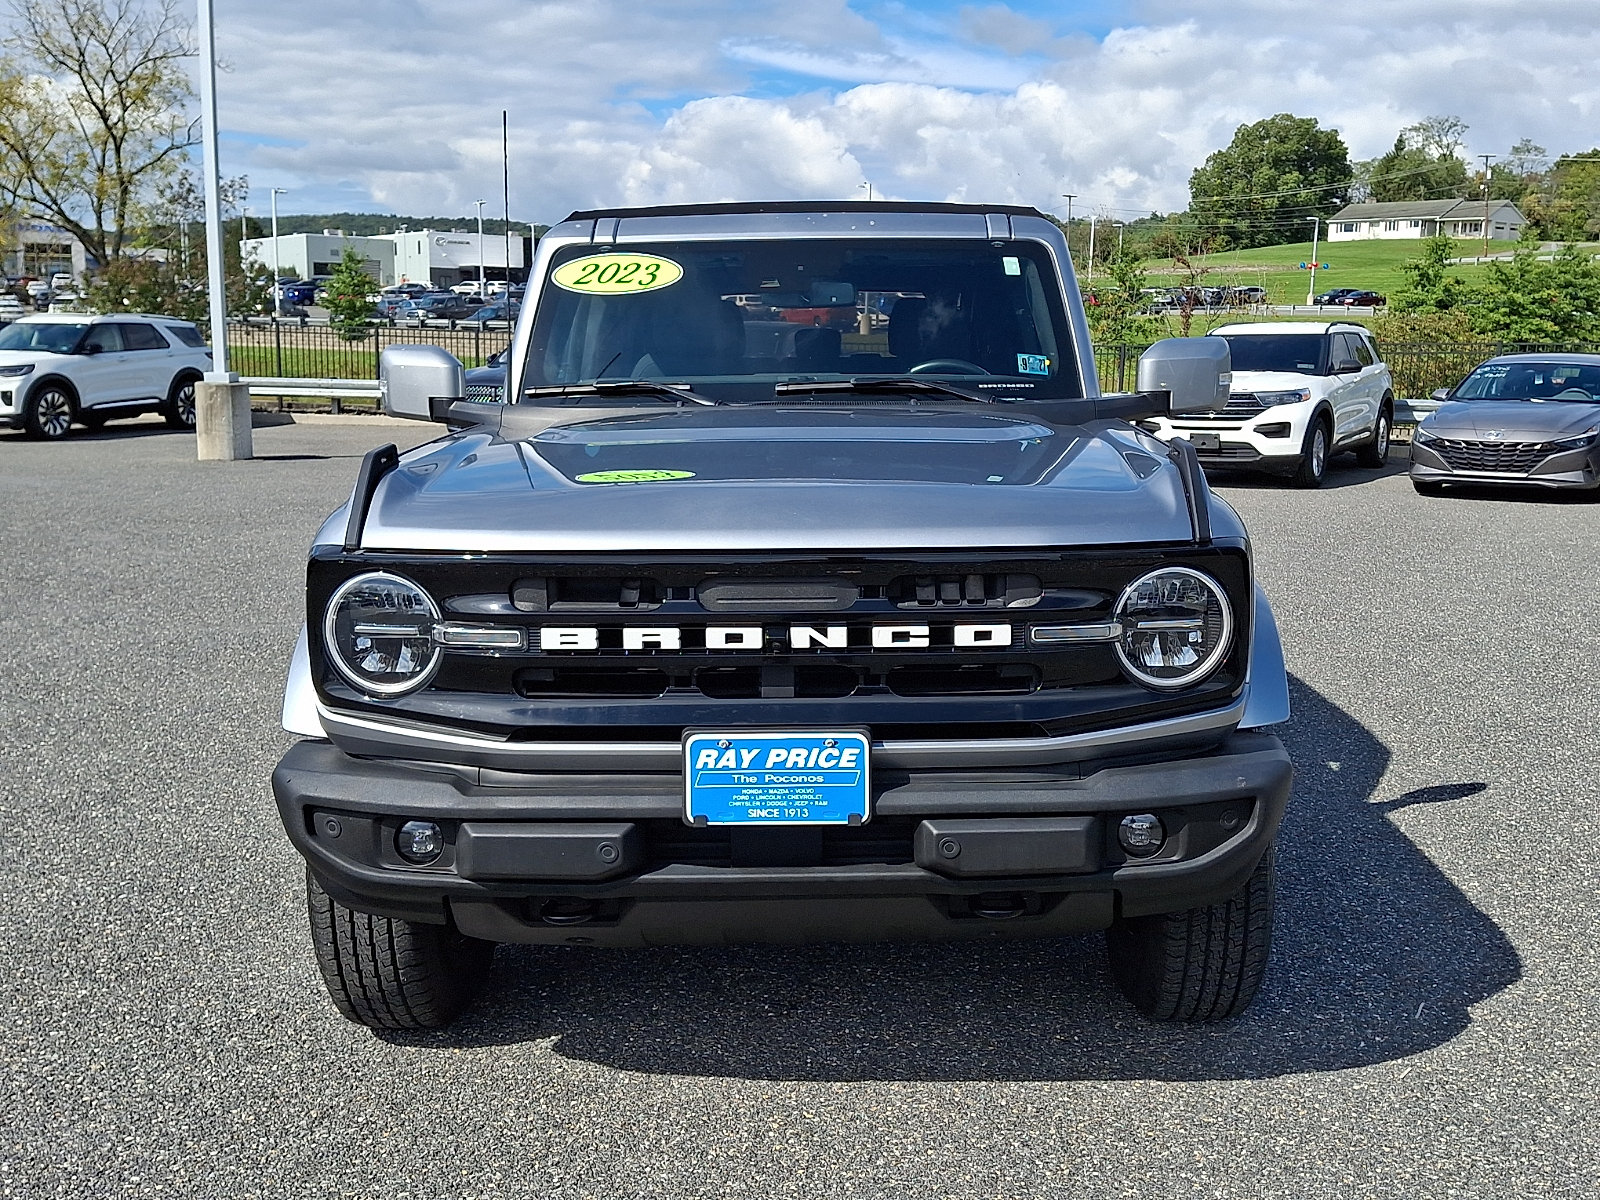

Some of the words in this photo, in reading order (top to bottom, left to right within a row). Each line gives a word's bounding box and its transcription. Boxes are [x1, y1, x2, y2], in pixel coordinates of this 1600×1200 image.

[573, 262, 661, 286] 2023
[539, 624, 1012, 650] BRONCO
[695, 748, 761, 769] RAY
[765, 747, 861, 769] PRICE
[731, 774, 758, 783] The
[764, 774, 825, 783] Poconos
[747, 808, 780, 818] SINCE
[783, 808, 809, 818] 1913
